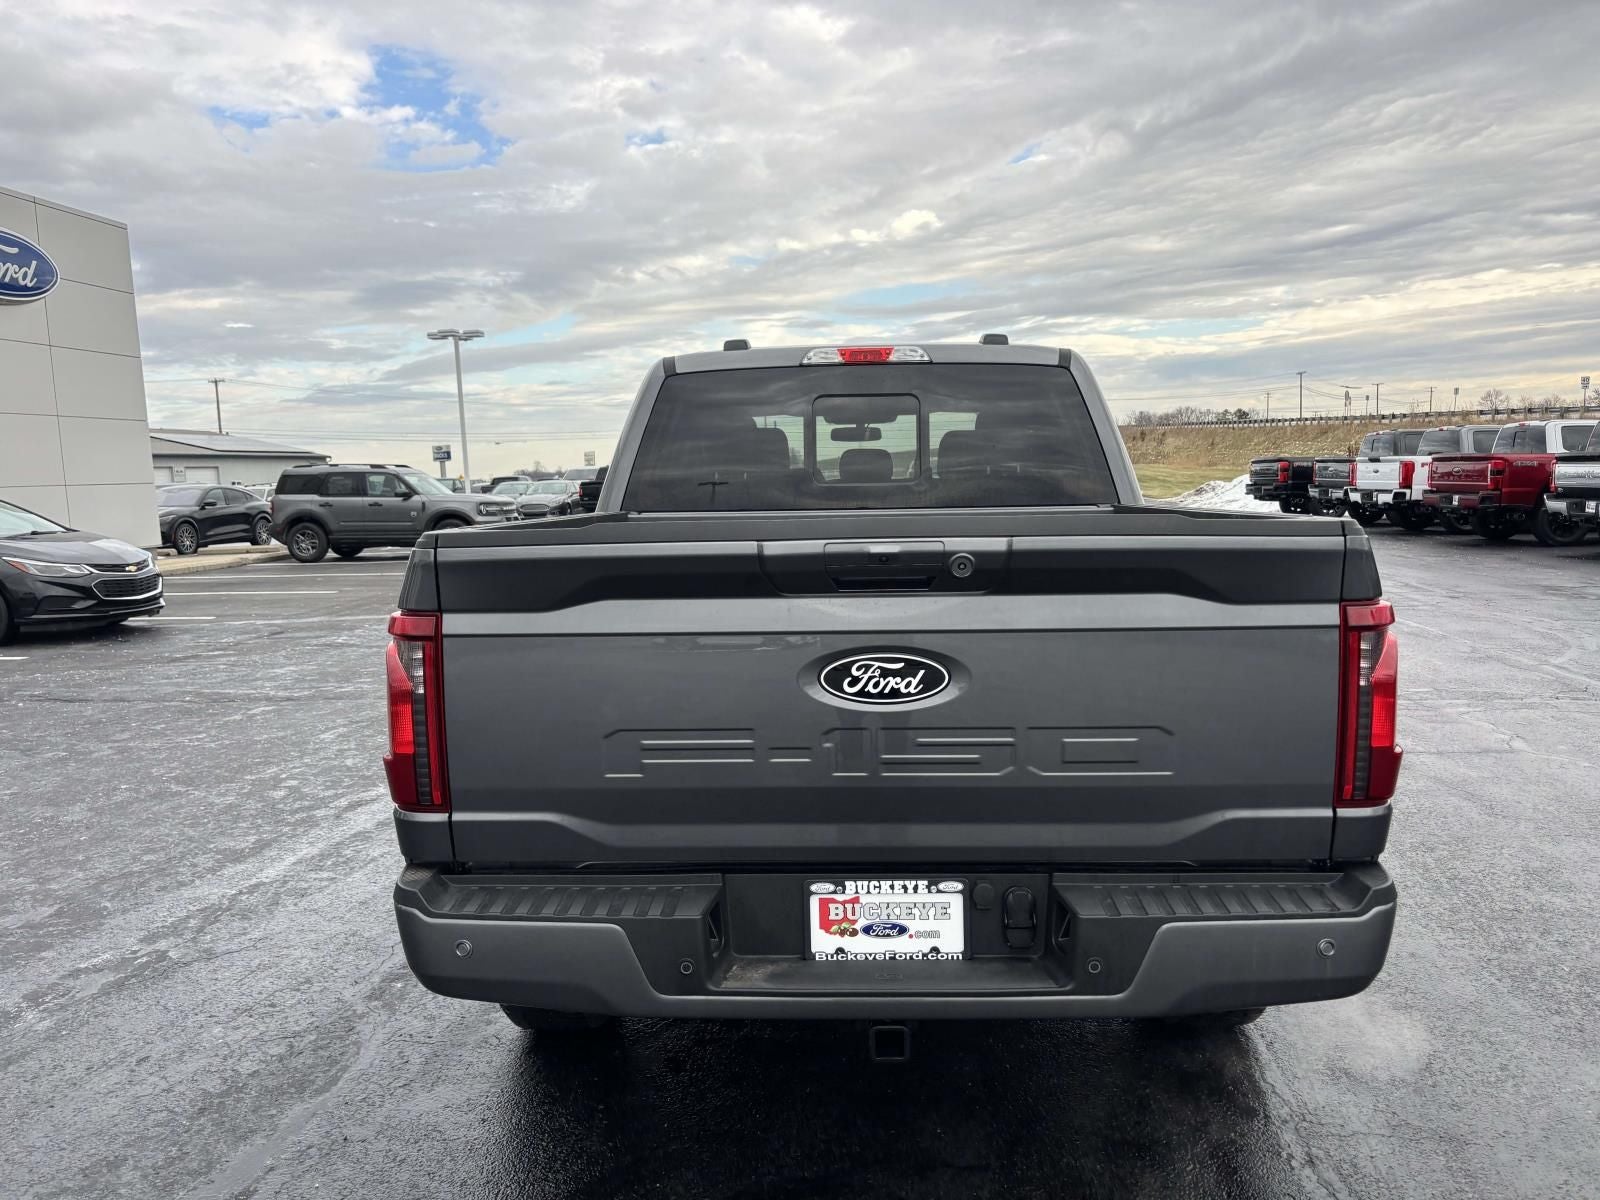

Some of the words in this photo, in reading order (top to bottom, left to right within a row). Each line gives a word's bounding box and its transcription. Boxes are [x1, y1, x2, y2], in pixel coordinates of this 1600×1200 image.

[842, 660, 926, 694] Ford
[602, 726, 1176, 778] F-150
[844, 880, 929, 894] BUCKEYE
[828, 902, 951, 920] BUCKEYE
[869, 924, 900, 936] Ford
[815, 951, 963, 960] BuckeyeFord.com
